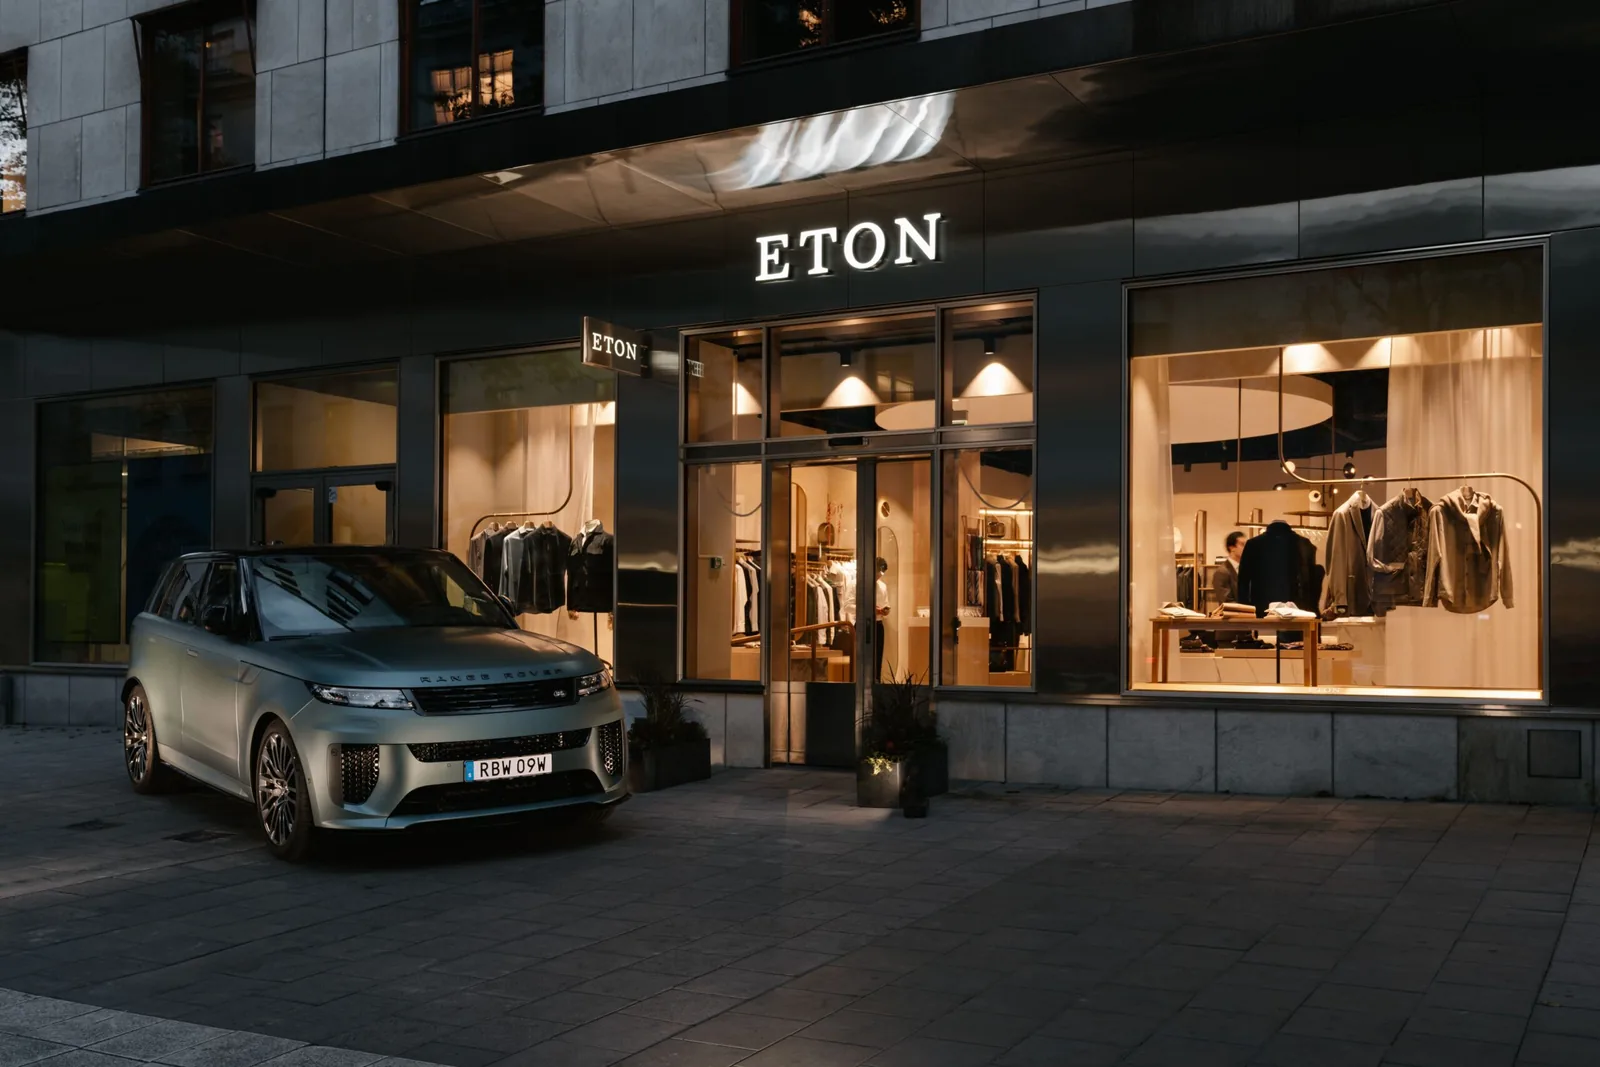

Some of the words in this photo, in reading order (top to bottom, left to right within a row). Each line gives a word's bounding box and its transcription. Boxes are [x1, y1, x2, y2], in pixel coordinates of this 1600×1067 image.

[755, 212, 942, 282] ETON
[591, 331, 637, 361] ETON
[420, 674, 490, 683] RANGE
[503, 668, 564, 680] ROVER
[480, 761, 511, 777] RBW
[516, 757, 546, 773] 09W
